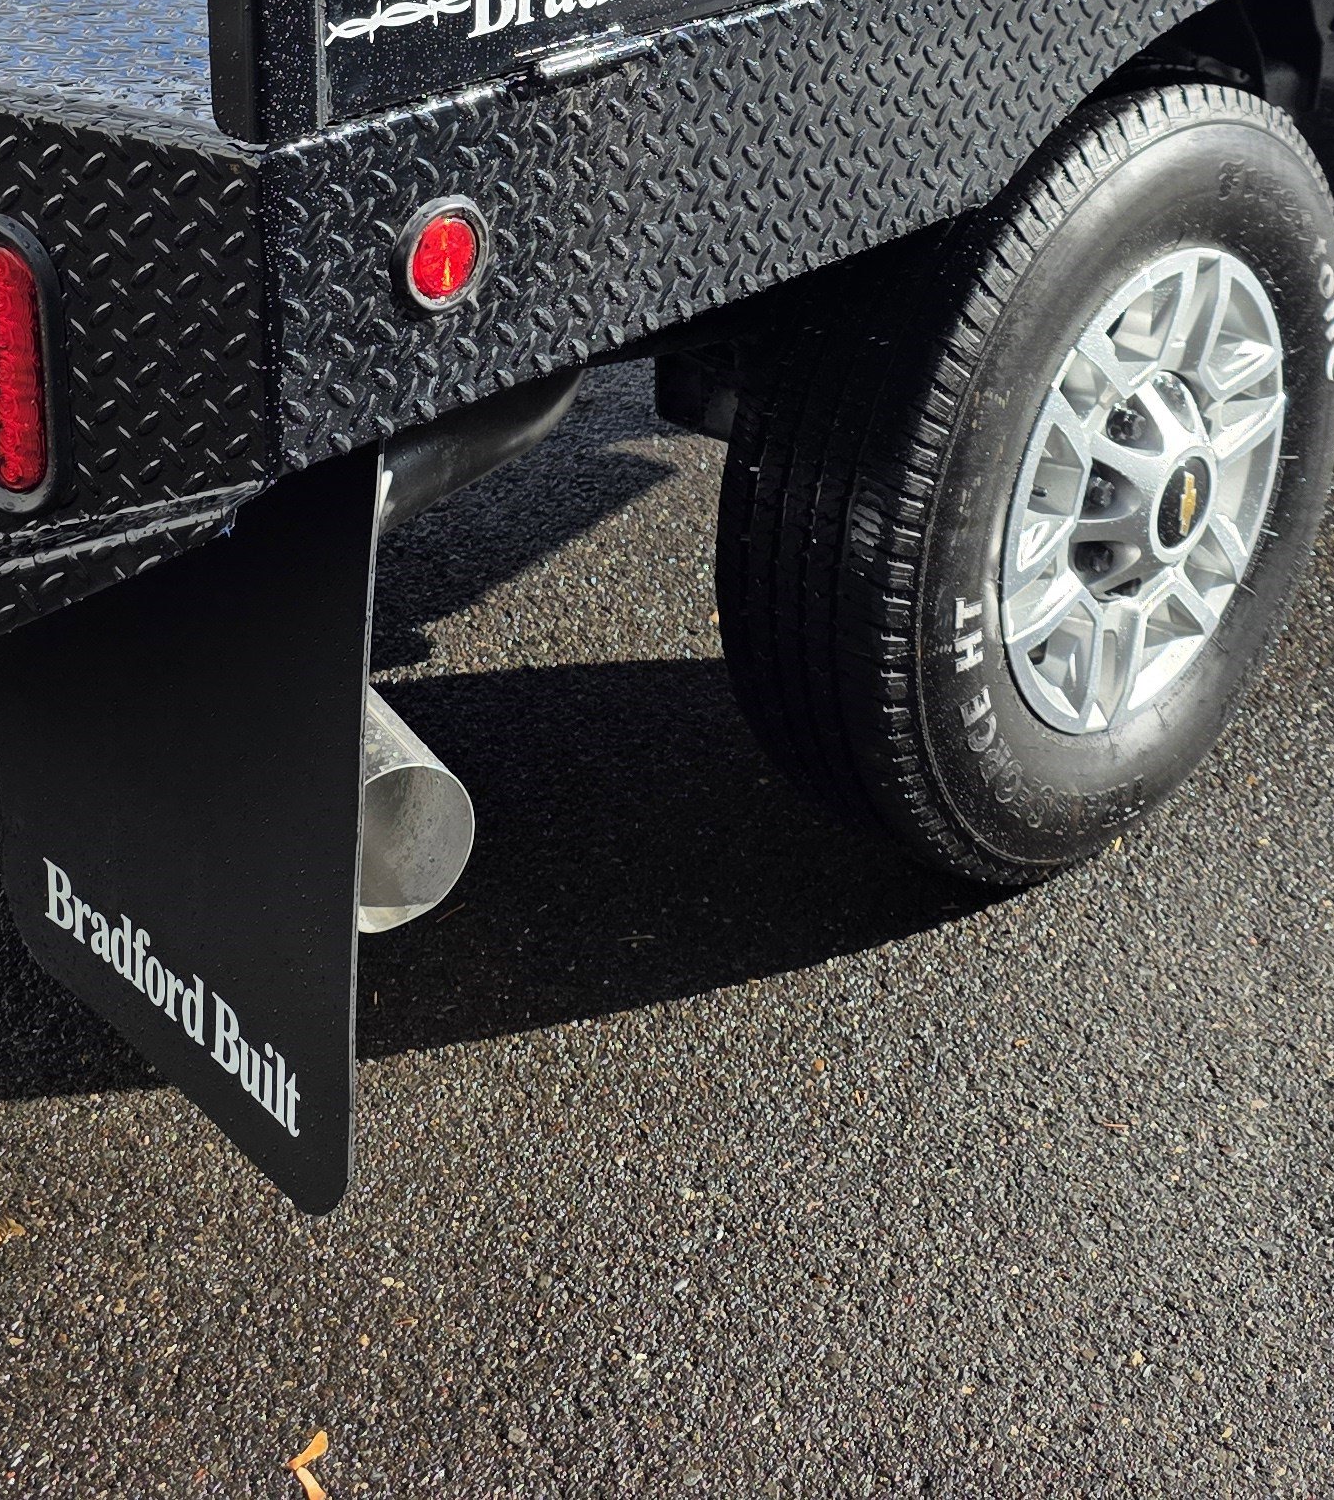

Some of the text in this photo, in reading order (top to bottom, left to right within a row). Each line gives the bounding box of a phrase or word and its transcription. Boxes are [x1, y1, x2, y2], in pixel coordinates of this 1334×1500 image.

[953, 597, 984, 673] HT
[43, 857, 301, 1138] Bradford Built
